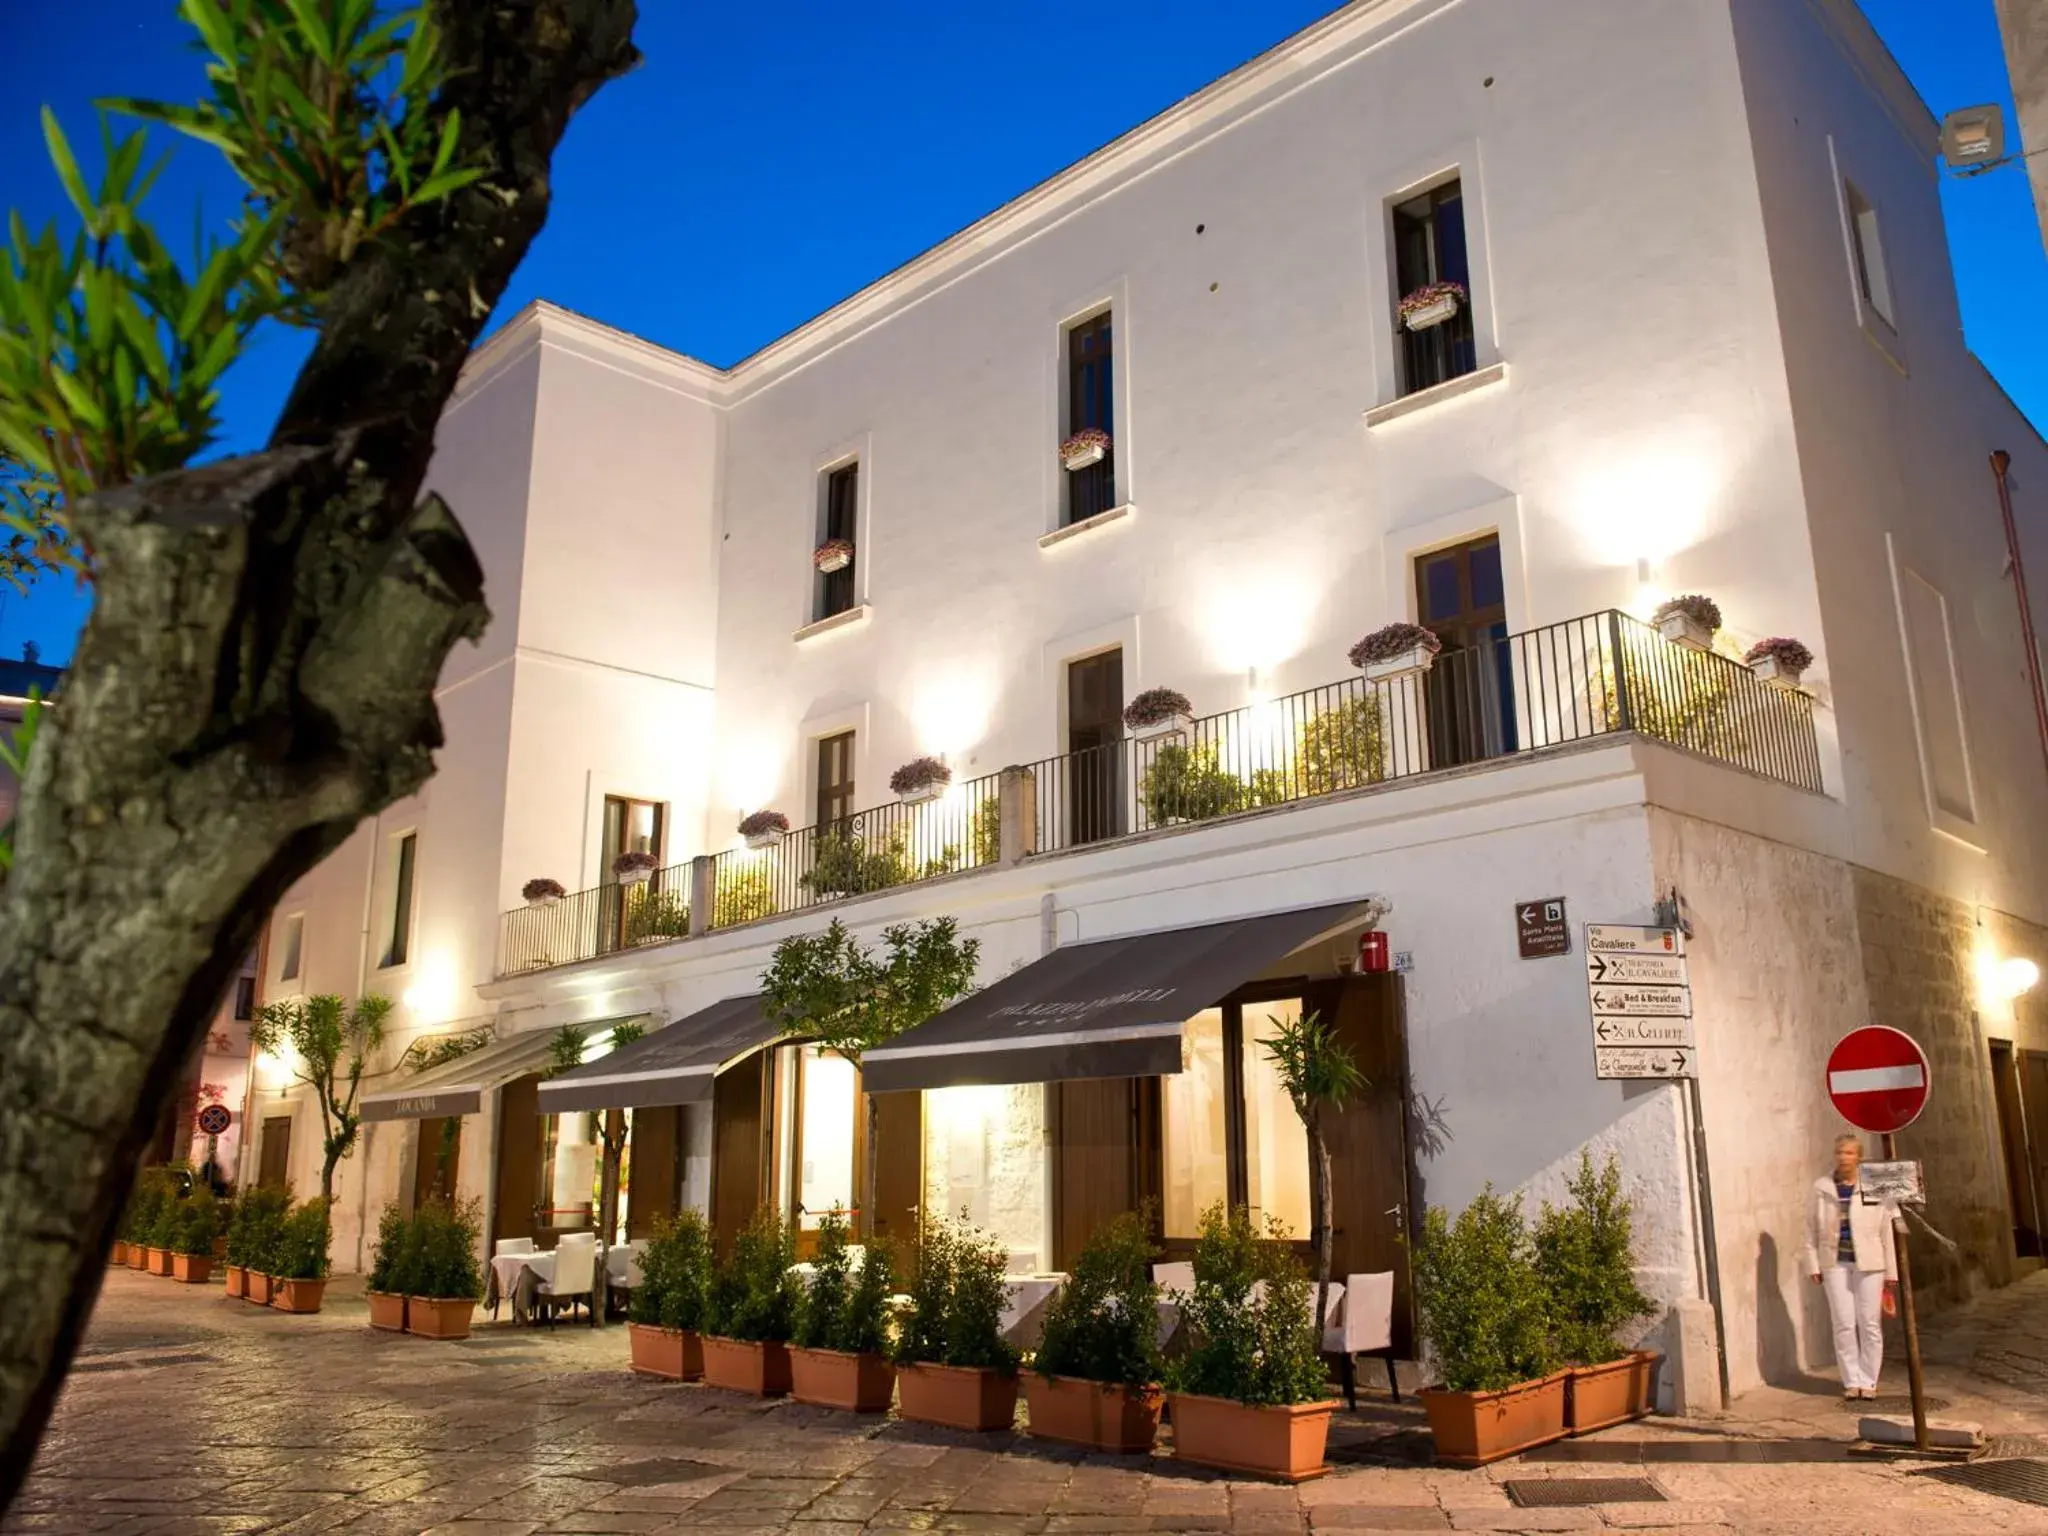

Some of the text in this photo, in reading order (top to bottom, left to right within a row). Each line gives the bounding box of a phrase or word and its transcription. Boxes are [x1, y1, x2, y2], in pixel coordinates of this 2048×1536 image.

[1590, 927, 1602, 935] Via
[1591, 937, 1636, 950] Cavaliere
[1624, 993, 1682, 1003] Bed & Breakfast
